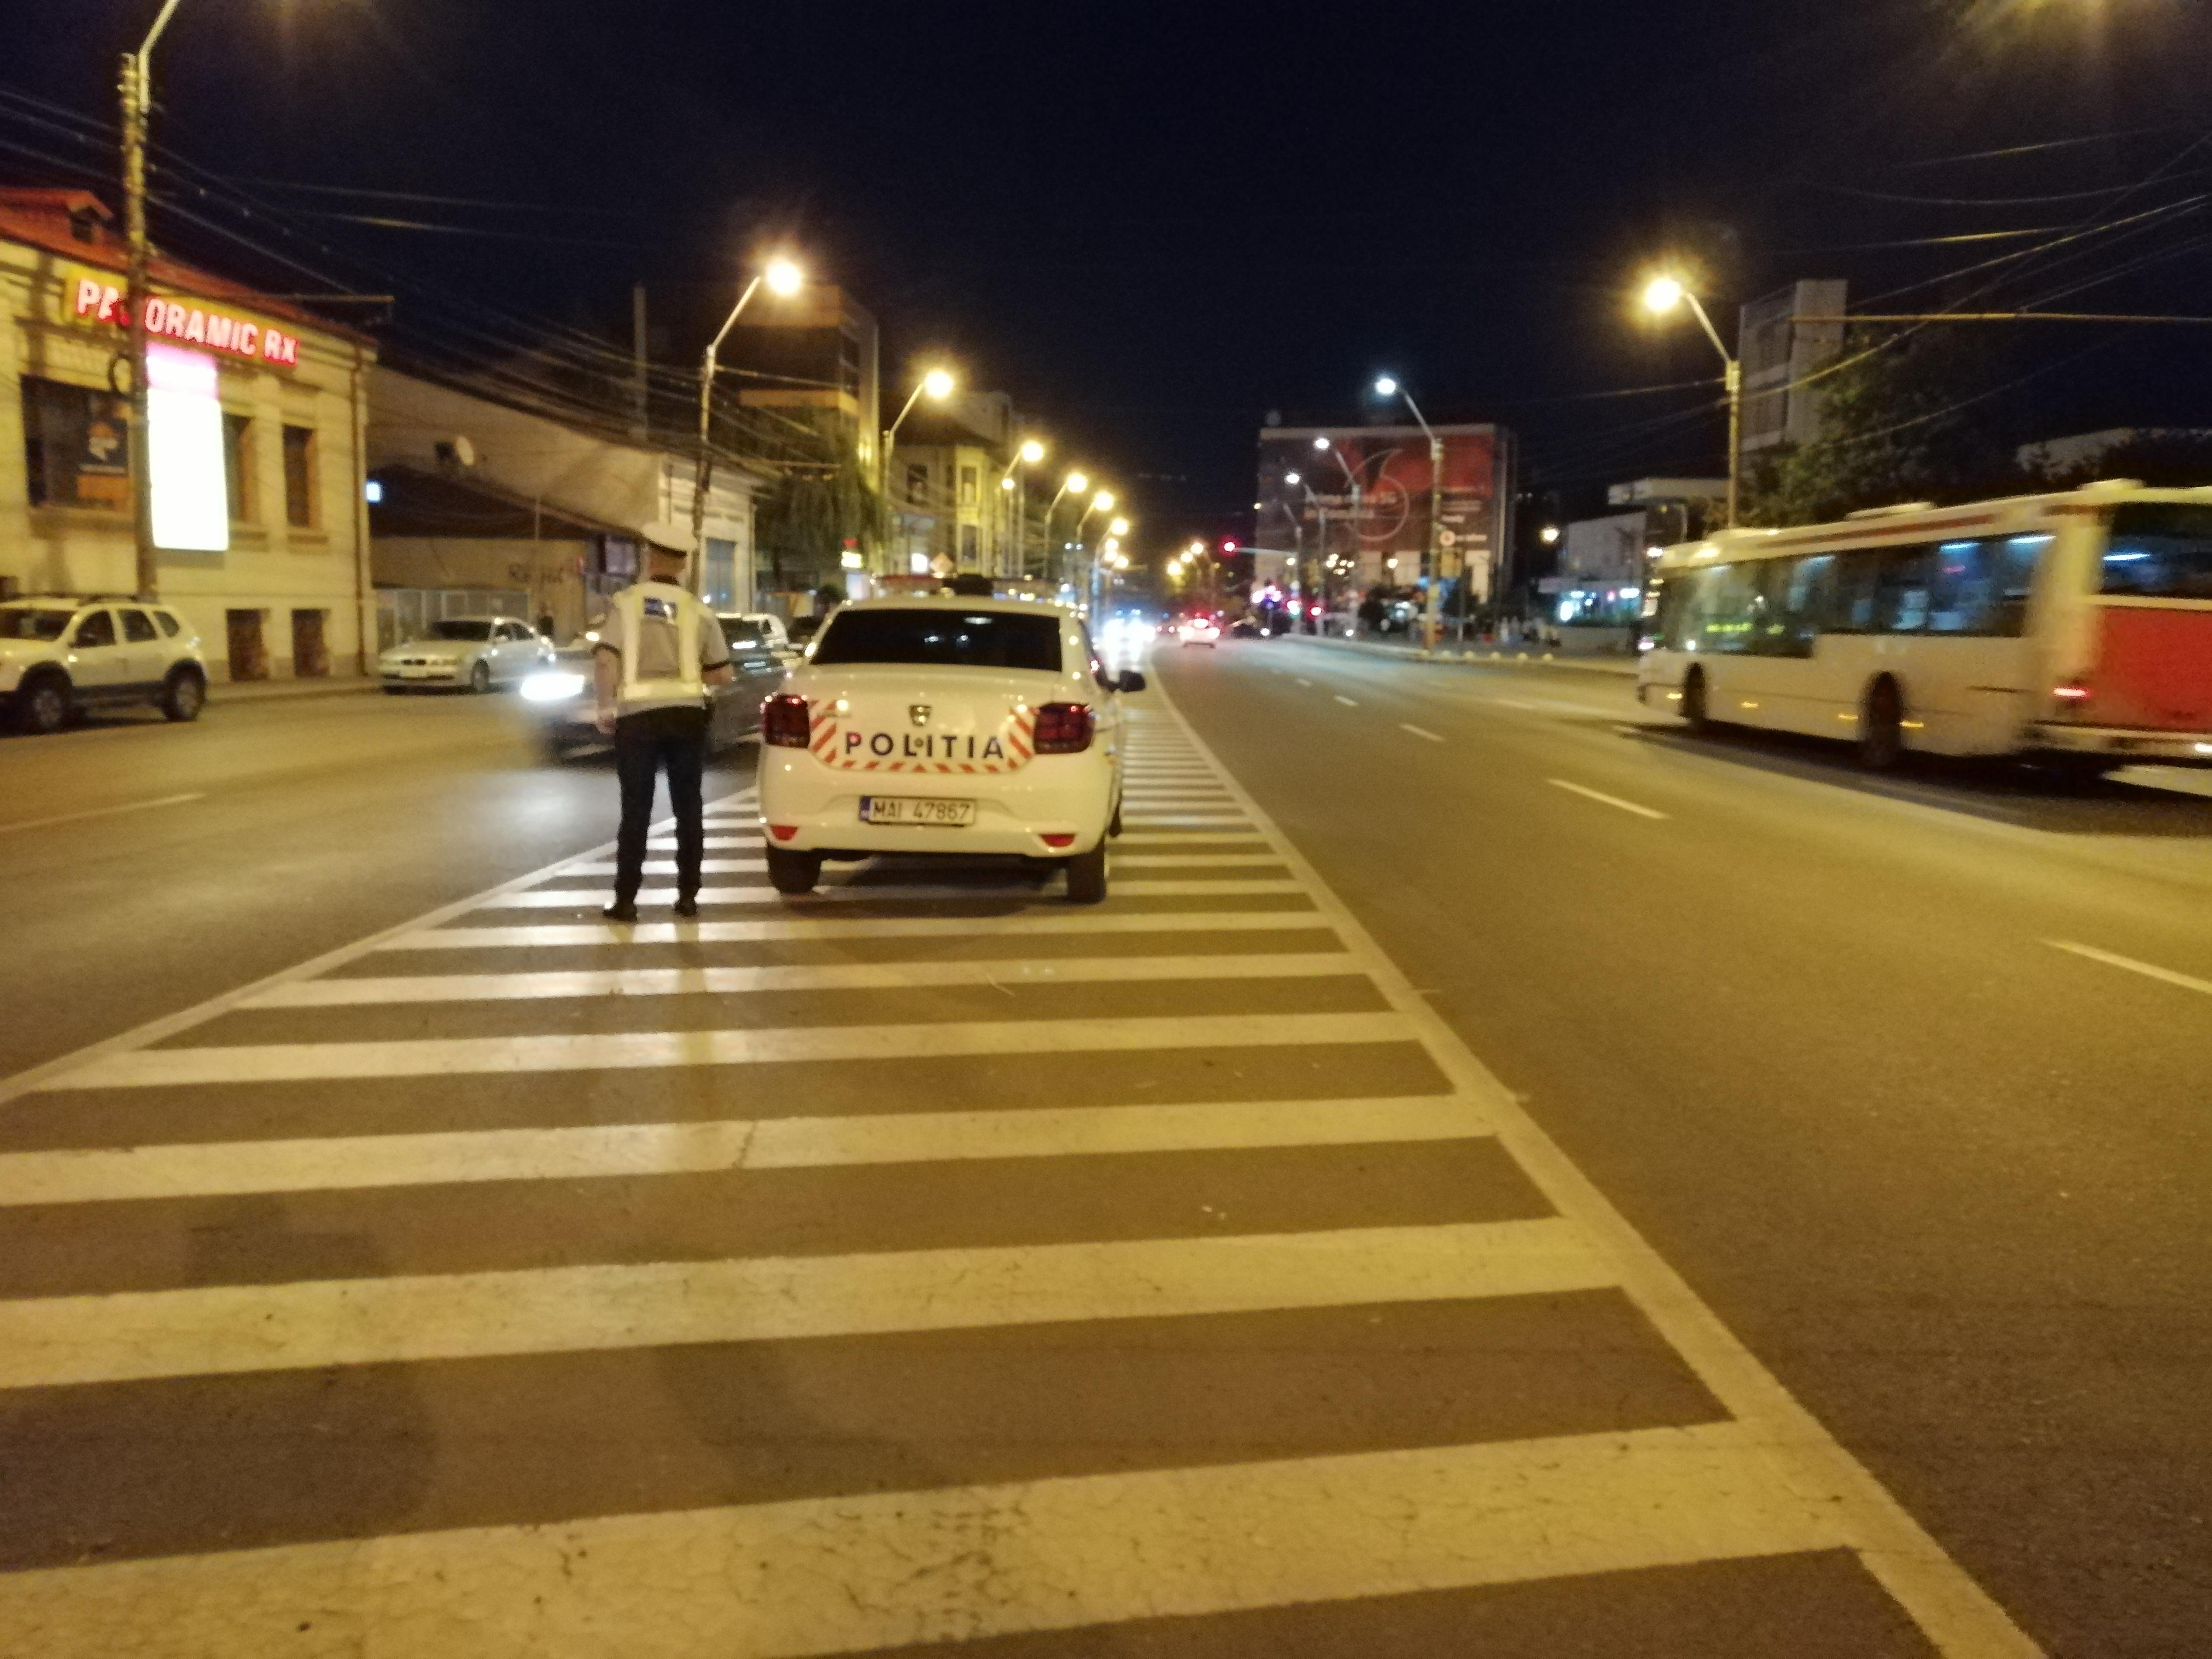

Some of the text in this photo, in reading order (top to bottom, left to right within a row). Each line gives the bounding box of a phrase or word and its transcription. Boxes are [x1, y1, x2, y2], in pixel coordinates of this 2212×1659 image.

[77, 279, 258, 356] PAORAMIC
[845, 732, 1004, 759] POLITIA
[872, 801, 903, 817] MAI
